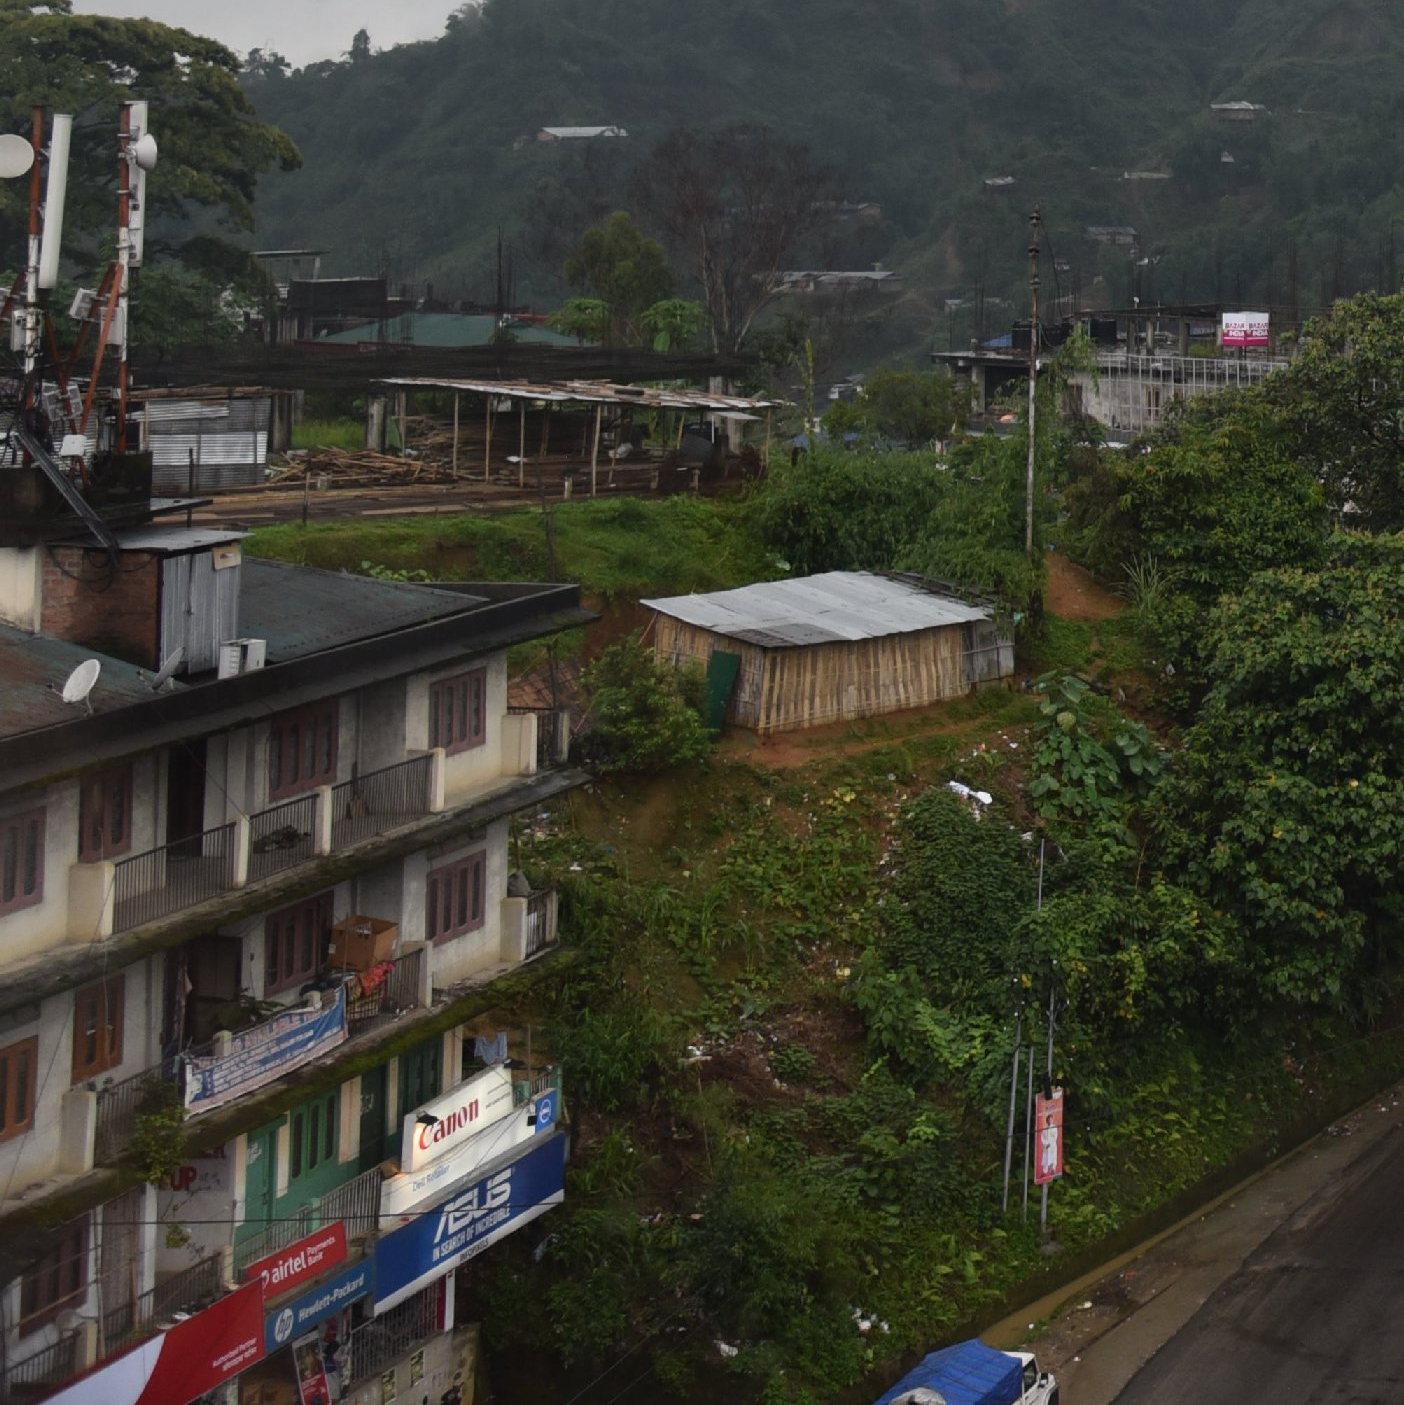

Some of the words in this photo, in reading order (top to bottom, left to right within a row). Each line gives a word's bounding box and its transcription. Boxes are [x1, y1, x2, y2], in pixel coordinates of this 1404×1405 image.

[419, 1097, 480, 1151] Canon
[433, 1167, 512, 1244] ASUS
[271, 1251, 307, 1284] airtel
[307, 1235, 336, 1256] Payments
[307, 1251, 323, 1267] Bank
[440, 1232, 466, 1258] SEARCH
[298, 1272, 365, 1323] Hewlett-Packard
